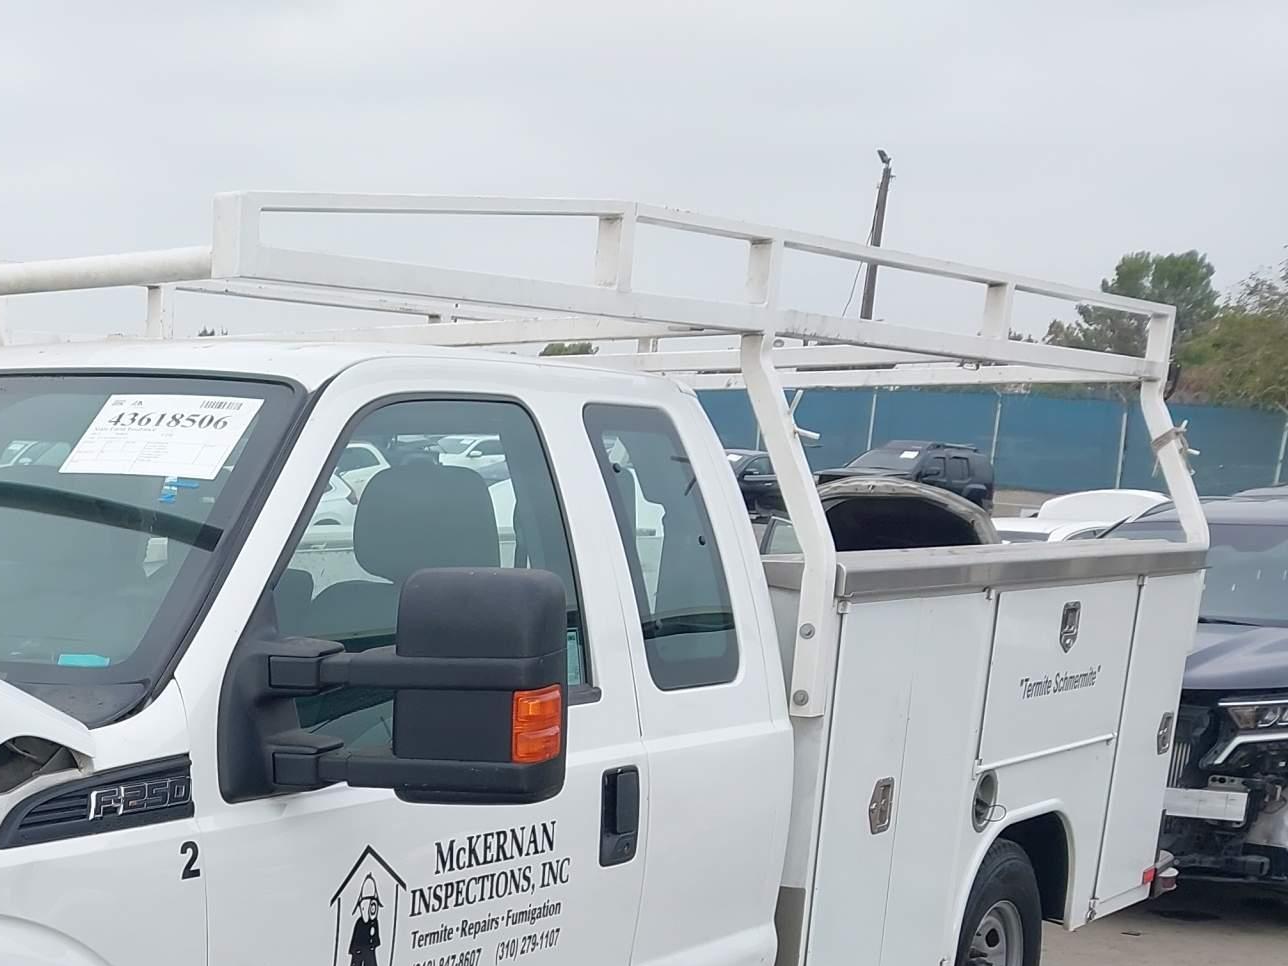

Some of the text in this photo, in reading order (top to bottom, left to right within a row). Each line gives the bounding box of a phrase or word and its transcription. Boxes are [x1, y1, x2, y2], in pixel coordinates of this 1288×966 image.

[108, 411, 232, 430] 43618506
[180, 841, 201, 880] 2
[434, 820, 557, 875] McKERNAN
[409, 857, 571, 917] INSPECTIONS, INC
[411, 899, 562, 949] Termite Repairs Fumigation
[494, 937, 520, 966] (310)
[519, 928, 561, 956] 279-1107
